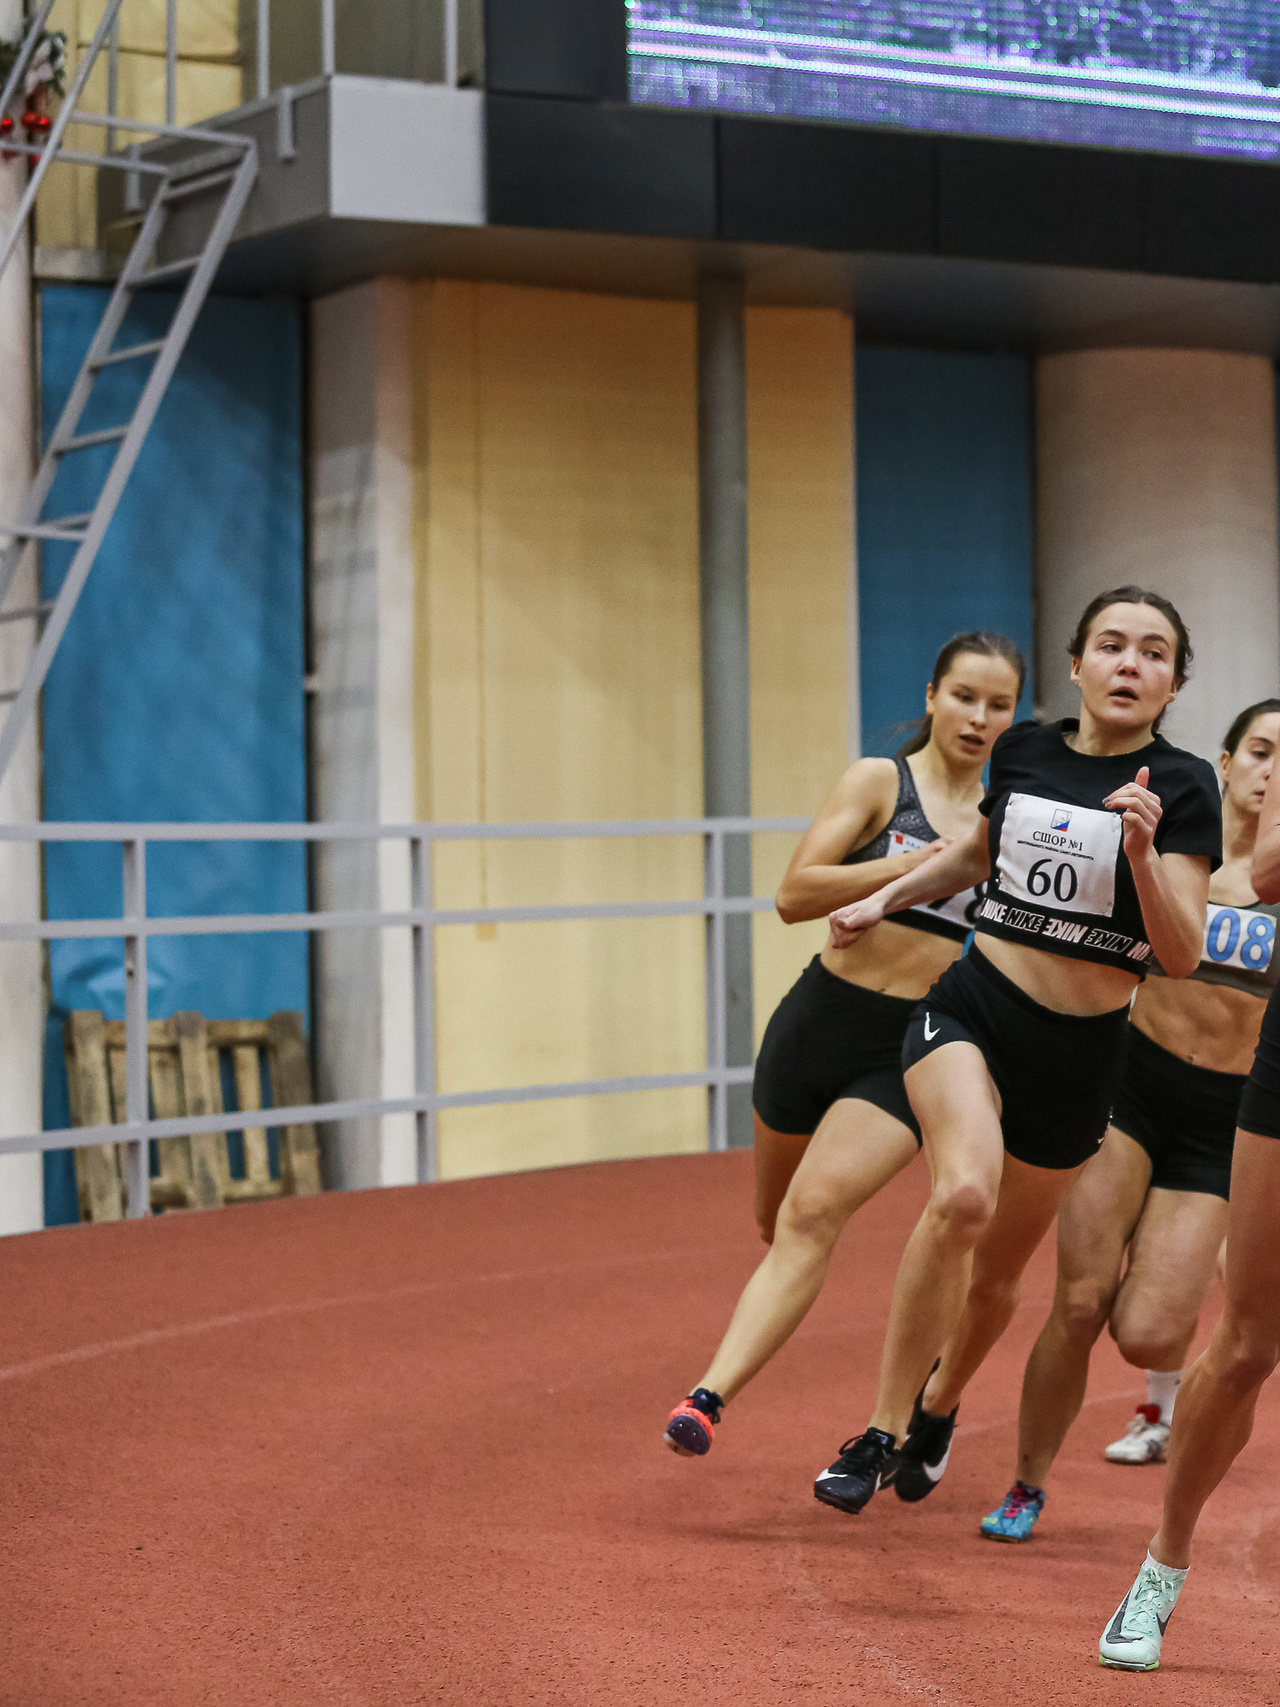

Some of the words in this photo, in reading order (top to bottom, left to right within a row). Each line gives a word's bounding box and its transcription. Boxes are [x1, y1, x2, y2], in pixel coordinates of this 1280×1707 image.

[1032, 831, 1067, 847] СШОР
[1026, 858, 1078, 902] 60
[980, 898, 1008, 923] NIKE
[1005, 907, 1045, 933] NIKE
[1205, 908, 1276, 970] 08
